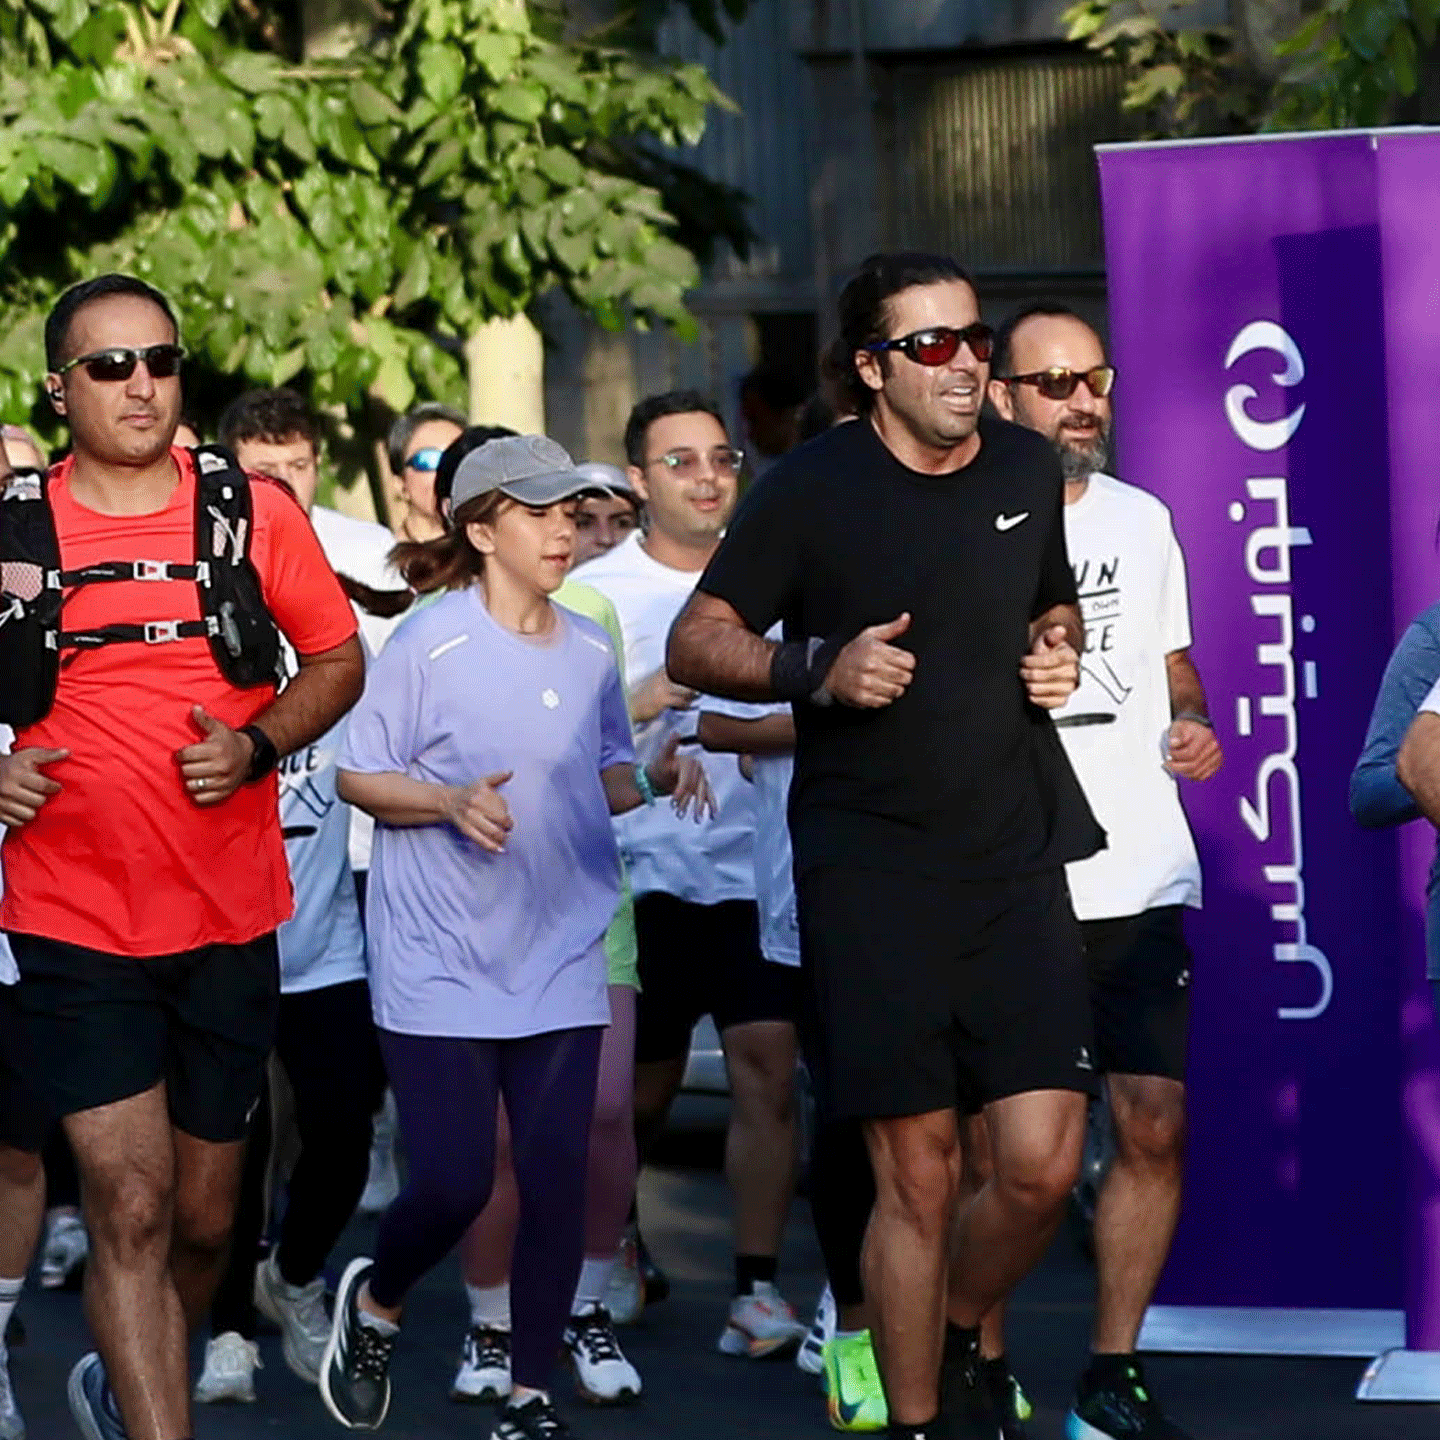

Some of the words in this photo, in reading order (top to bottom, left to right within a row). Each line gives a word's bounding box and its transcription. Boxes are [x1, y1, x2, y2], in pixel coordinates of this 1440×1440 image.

[1070, 557, 1119, 588] UN
[1082, 624, 1115, 653] CE
[1227, 476, 1334, 1019] نوبیتکس
